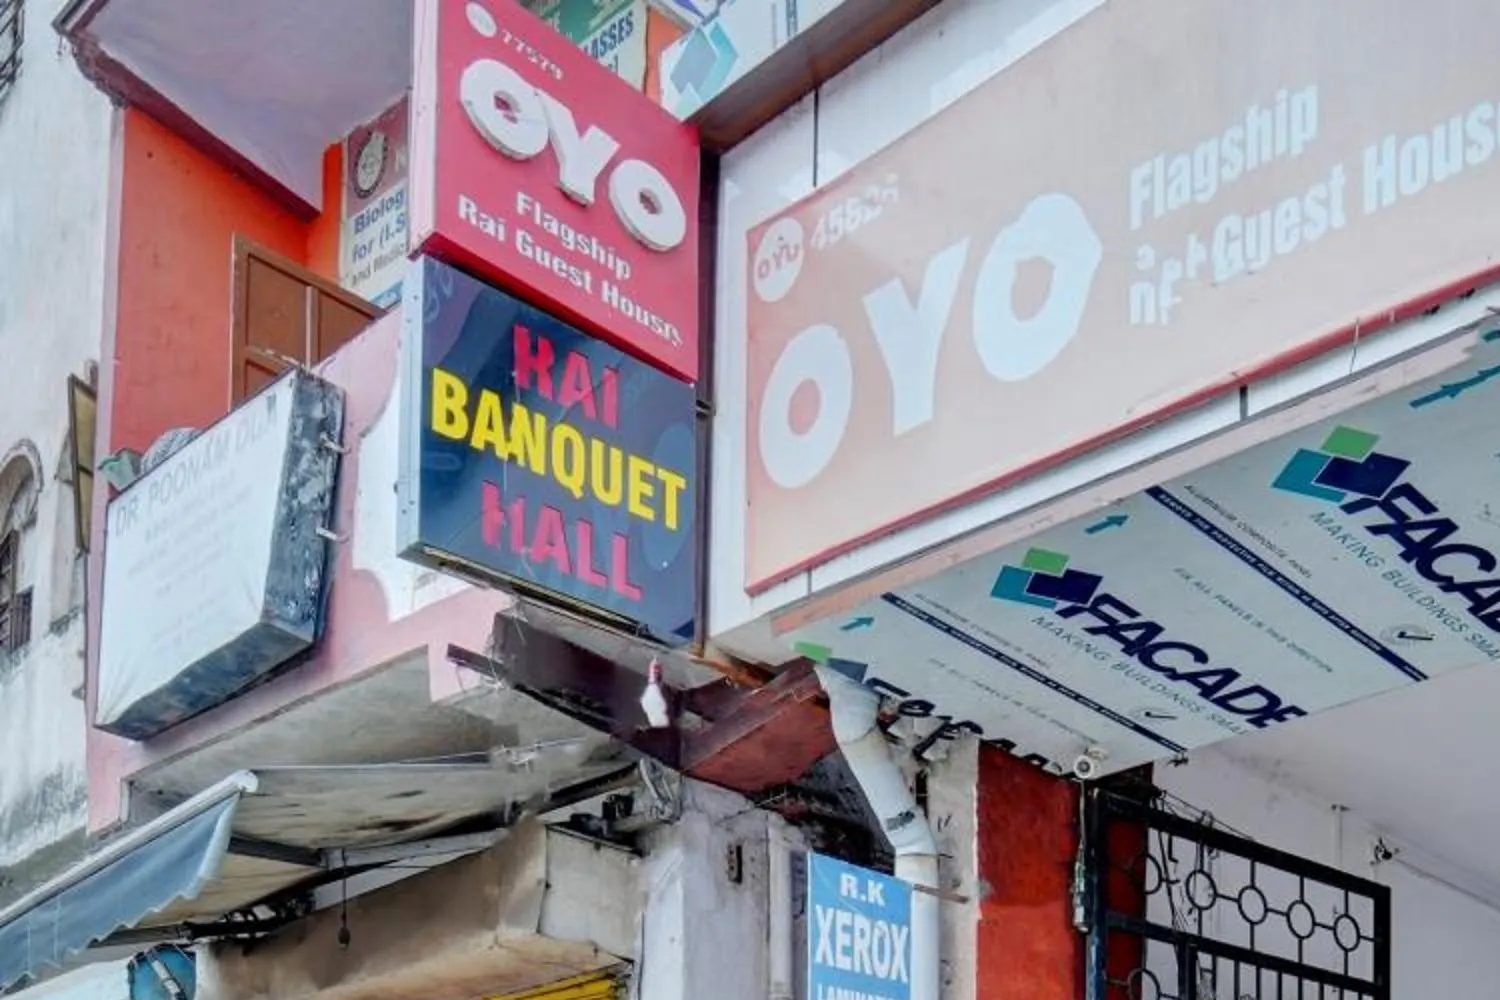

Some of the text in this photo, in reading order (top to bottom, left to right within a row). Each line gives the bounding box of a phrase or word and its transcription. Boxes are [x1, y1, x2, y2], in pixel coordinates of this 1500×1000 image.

[460, 58, 687, 253] OYO
[1130, 85, 1318, 231] Flagship
[458, 194, 506, 241] Rai
[515, 229, 592, 294] Guest
[516, 193, 632, 281] Flagship
[1211, 163, 1346, 284] Guest
[513, 324, 619, 428] RAI
[758, 193, 1102, 489] OYO
[432, 368, 686, 531] BANQUET
[481, 480, 642, 600] HALL
[1310, 511, 1385, 568] MAKING
[1382, 569, 1470, 633] BUILDINGS
[1055, 593, 1308, 728] FACADE
[814, 904, 909, 983] XEROX
[840, 872, 886, 906] R.K
